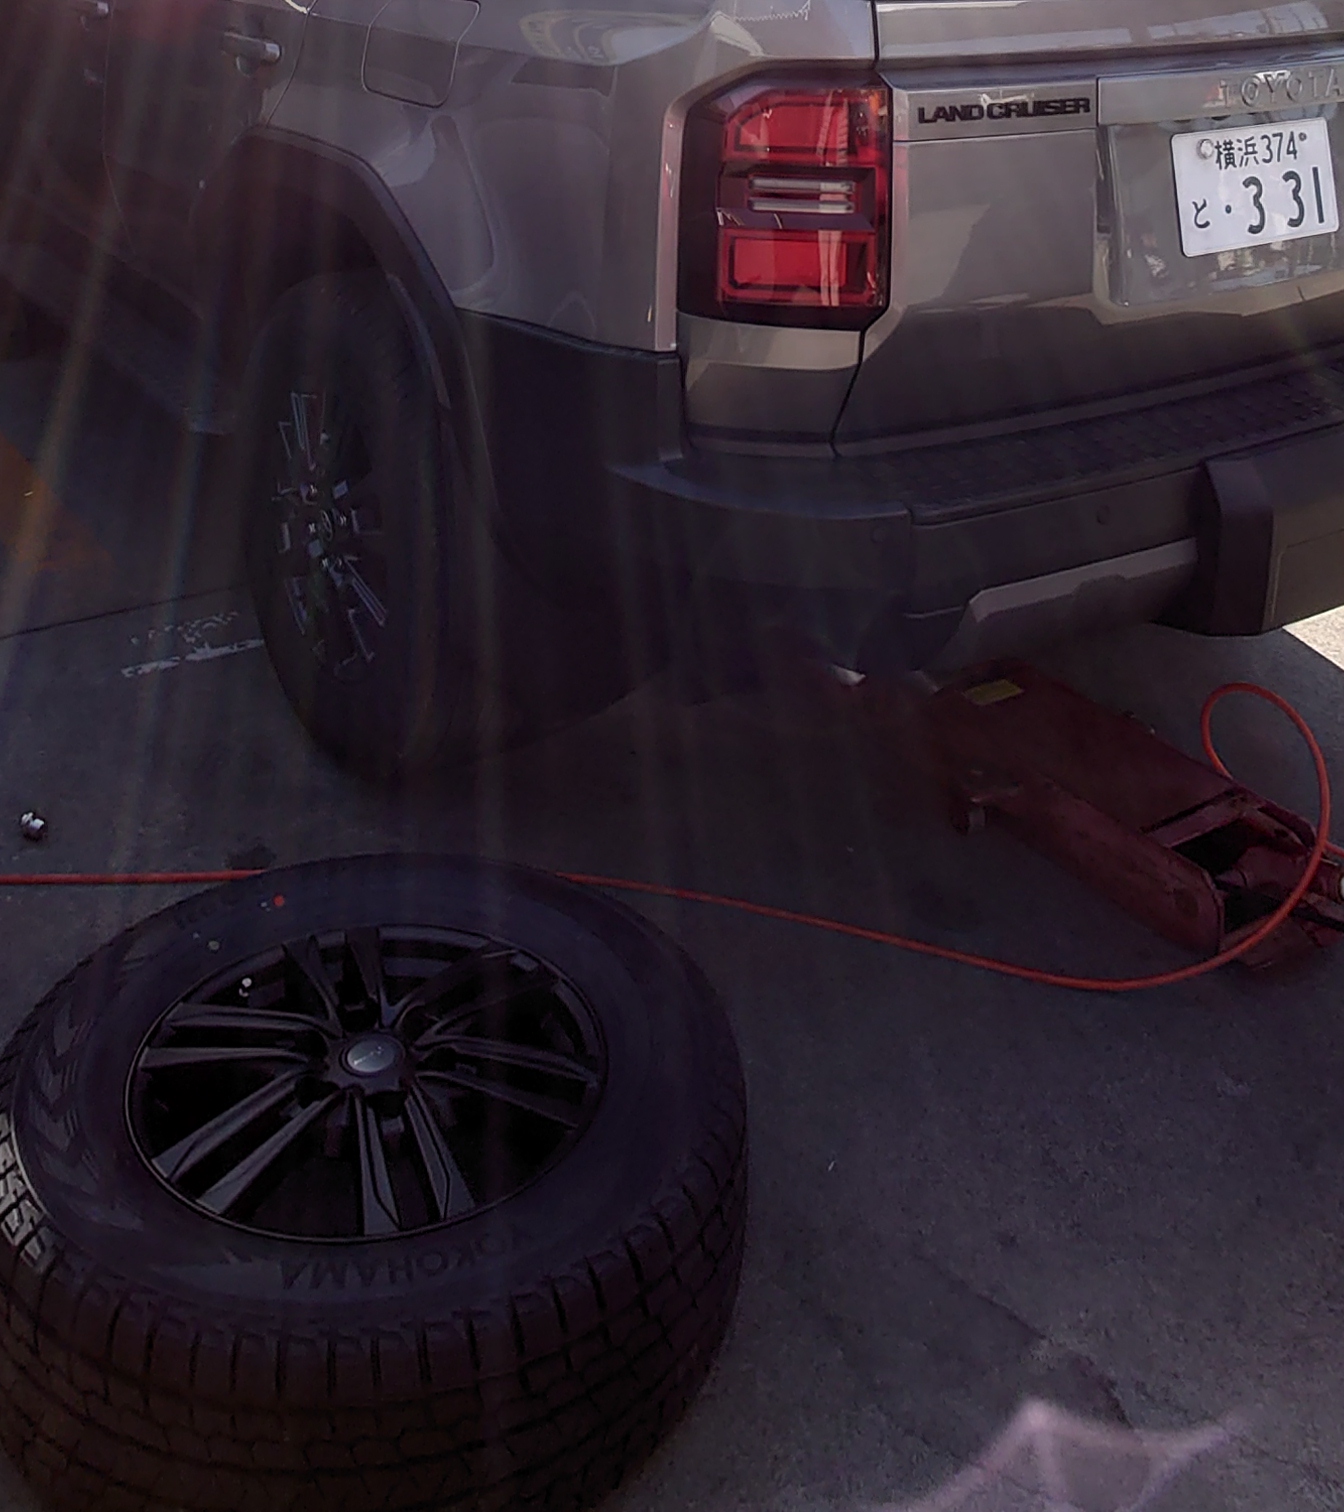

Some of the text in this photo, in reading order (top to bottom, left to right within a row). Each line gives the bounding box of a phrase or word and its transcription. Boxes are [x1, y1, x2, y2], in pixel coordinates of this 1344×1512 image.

[1213, 68, 1343, 107] TOYOTA
[917, 97, 1091, 124] LAND CRUISER
[1192, 198, 1211, 229] と
